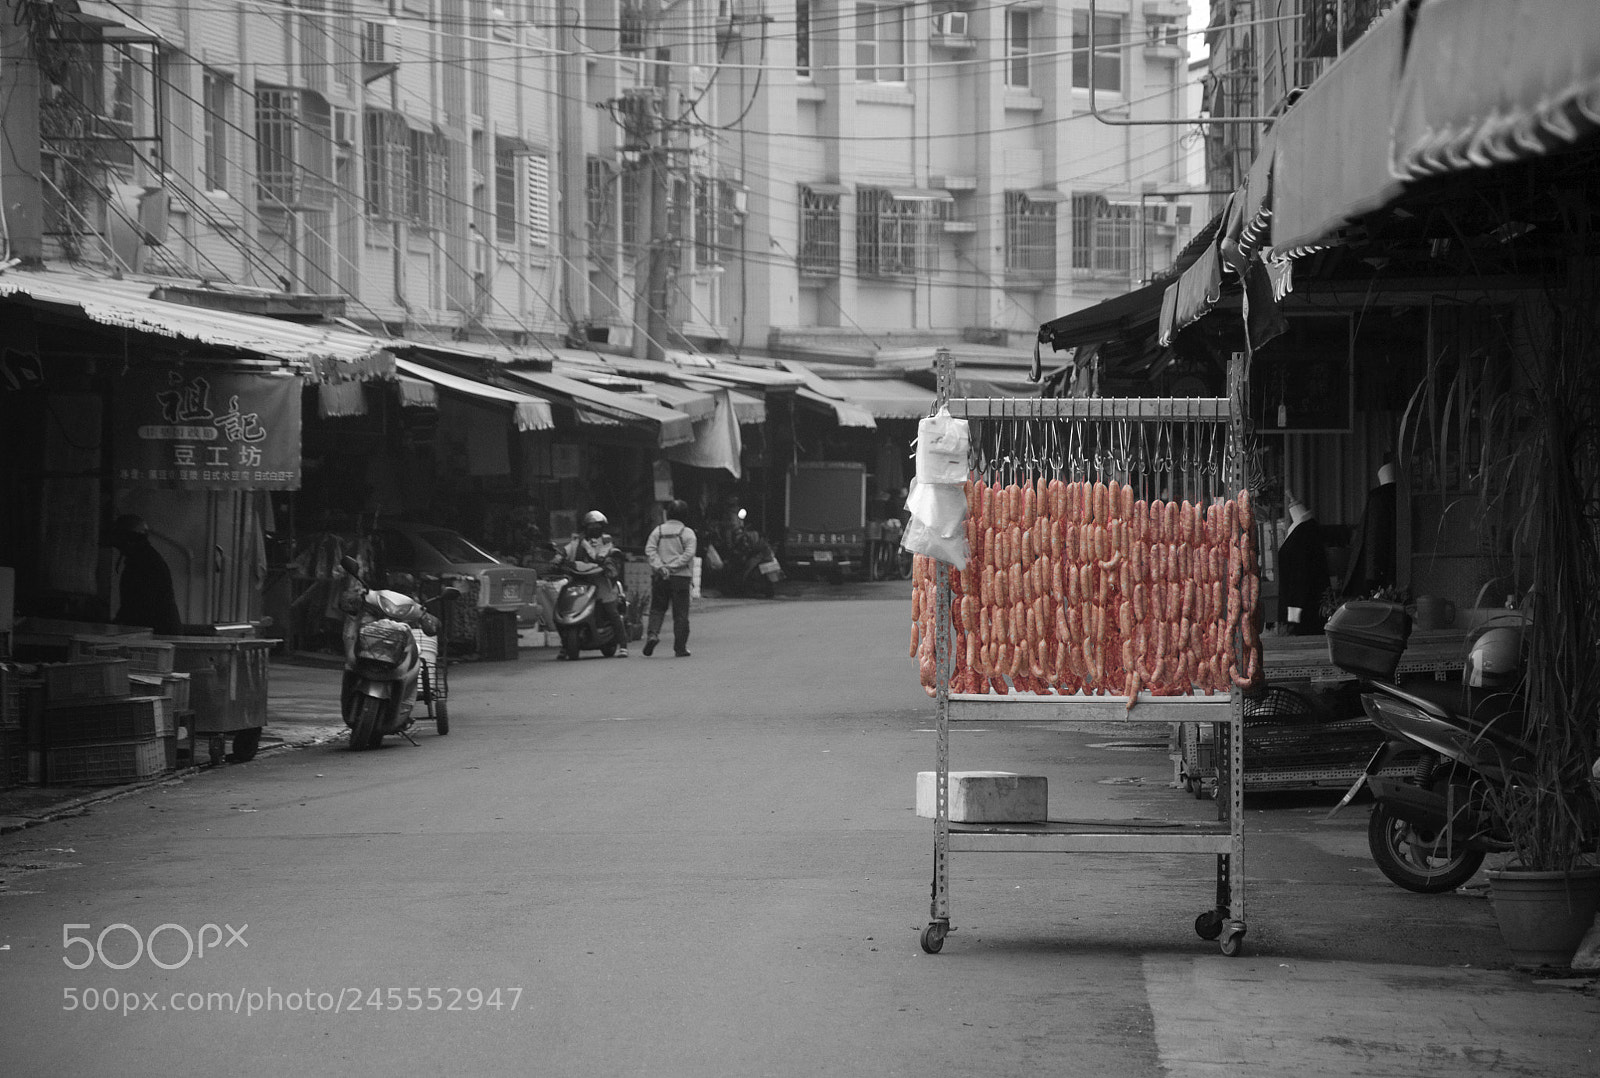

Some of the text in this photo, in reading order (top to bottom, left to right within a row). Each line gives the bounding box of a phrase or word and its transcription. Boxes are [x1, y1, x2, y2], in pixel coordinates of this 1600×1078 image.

[156, 371, 267, 442] 祖記
[174, 445, 262, 467] 豆工坊
